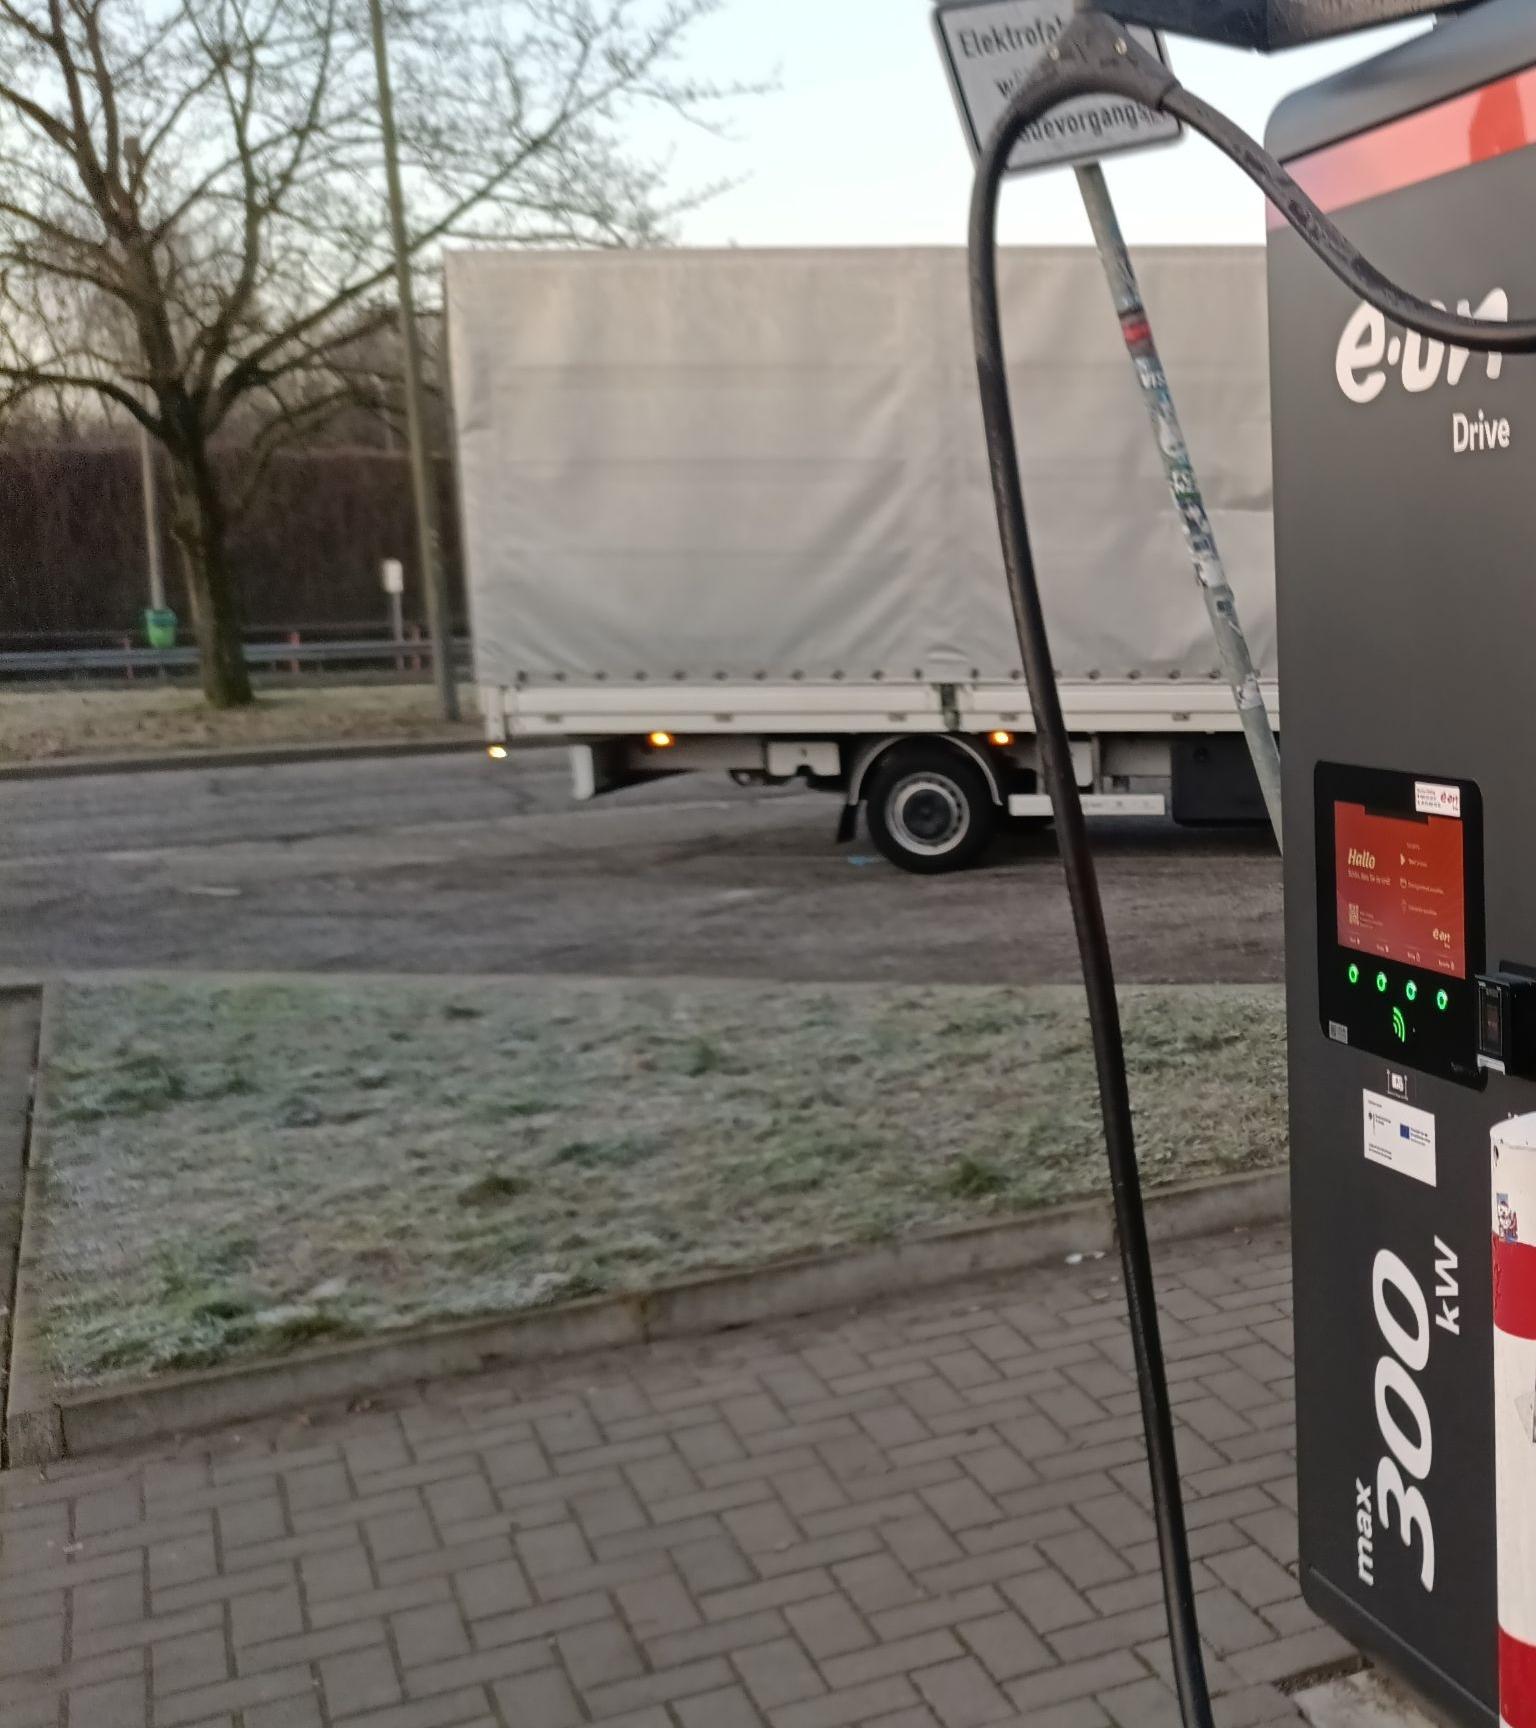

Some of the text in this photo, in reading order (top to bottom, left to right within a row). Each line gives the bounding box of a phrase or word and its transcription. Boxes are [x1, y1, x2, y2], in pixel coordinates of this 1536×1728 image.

[1452, 408, 1511, 453] Drive
[1347, 847, 1376, 870] Hallo
[1356, 1234, 1460, 1592] max 300 kW
